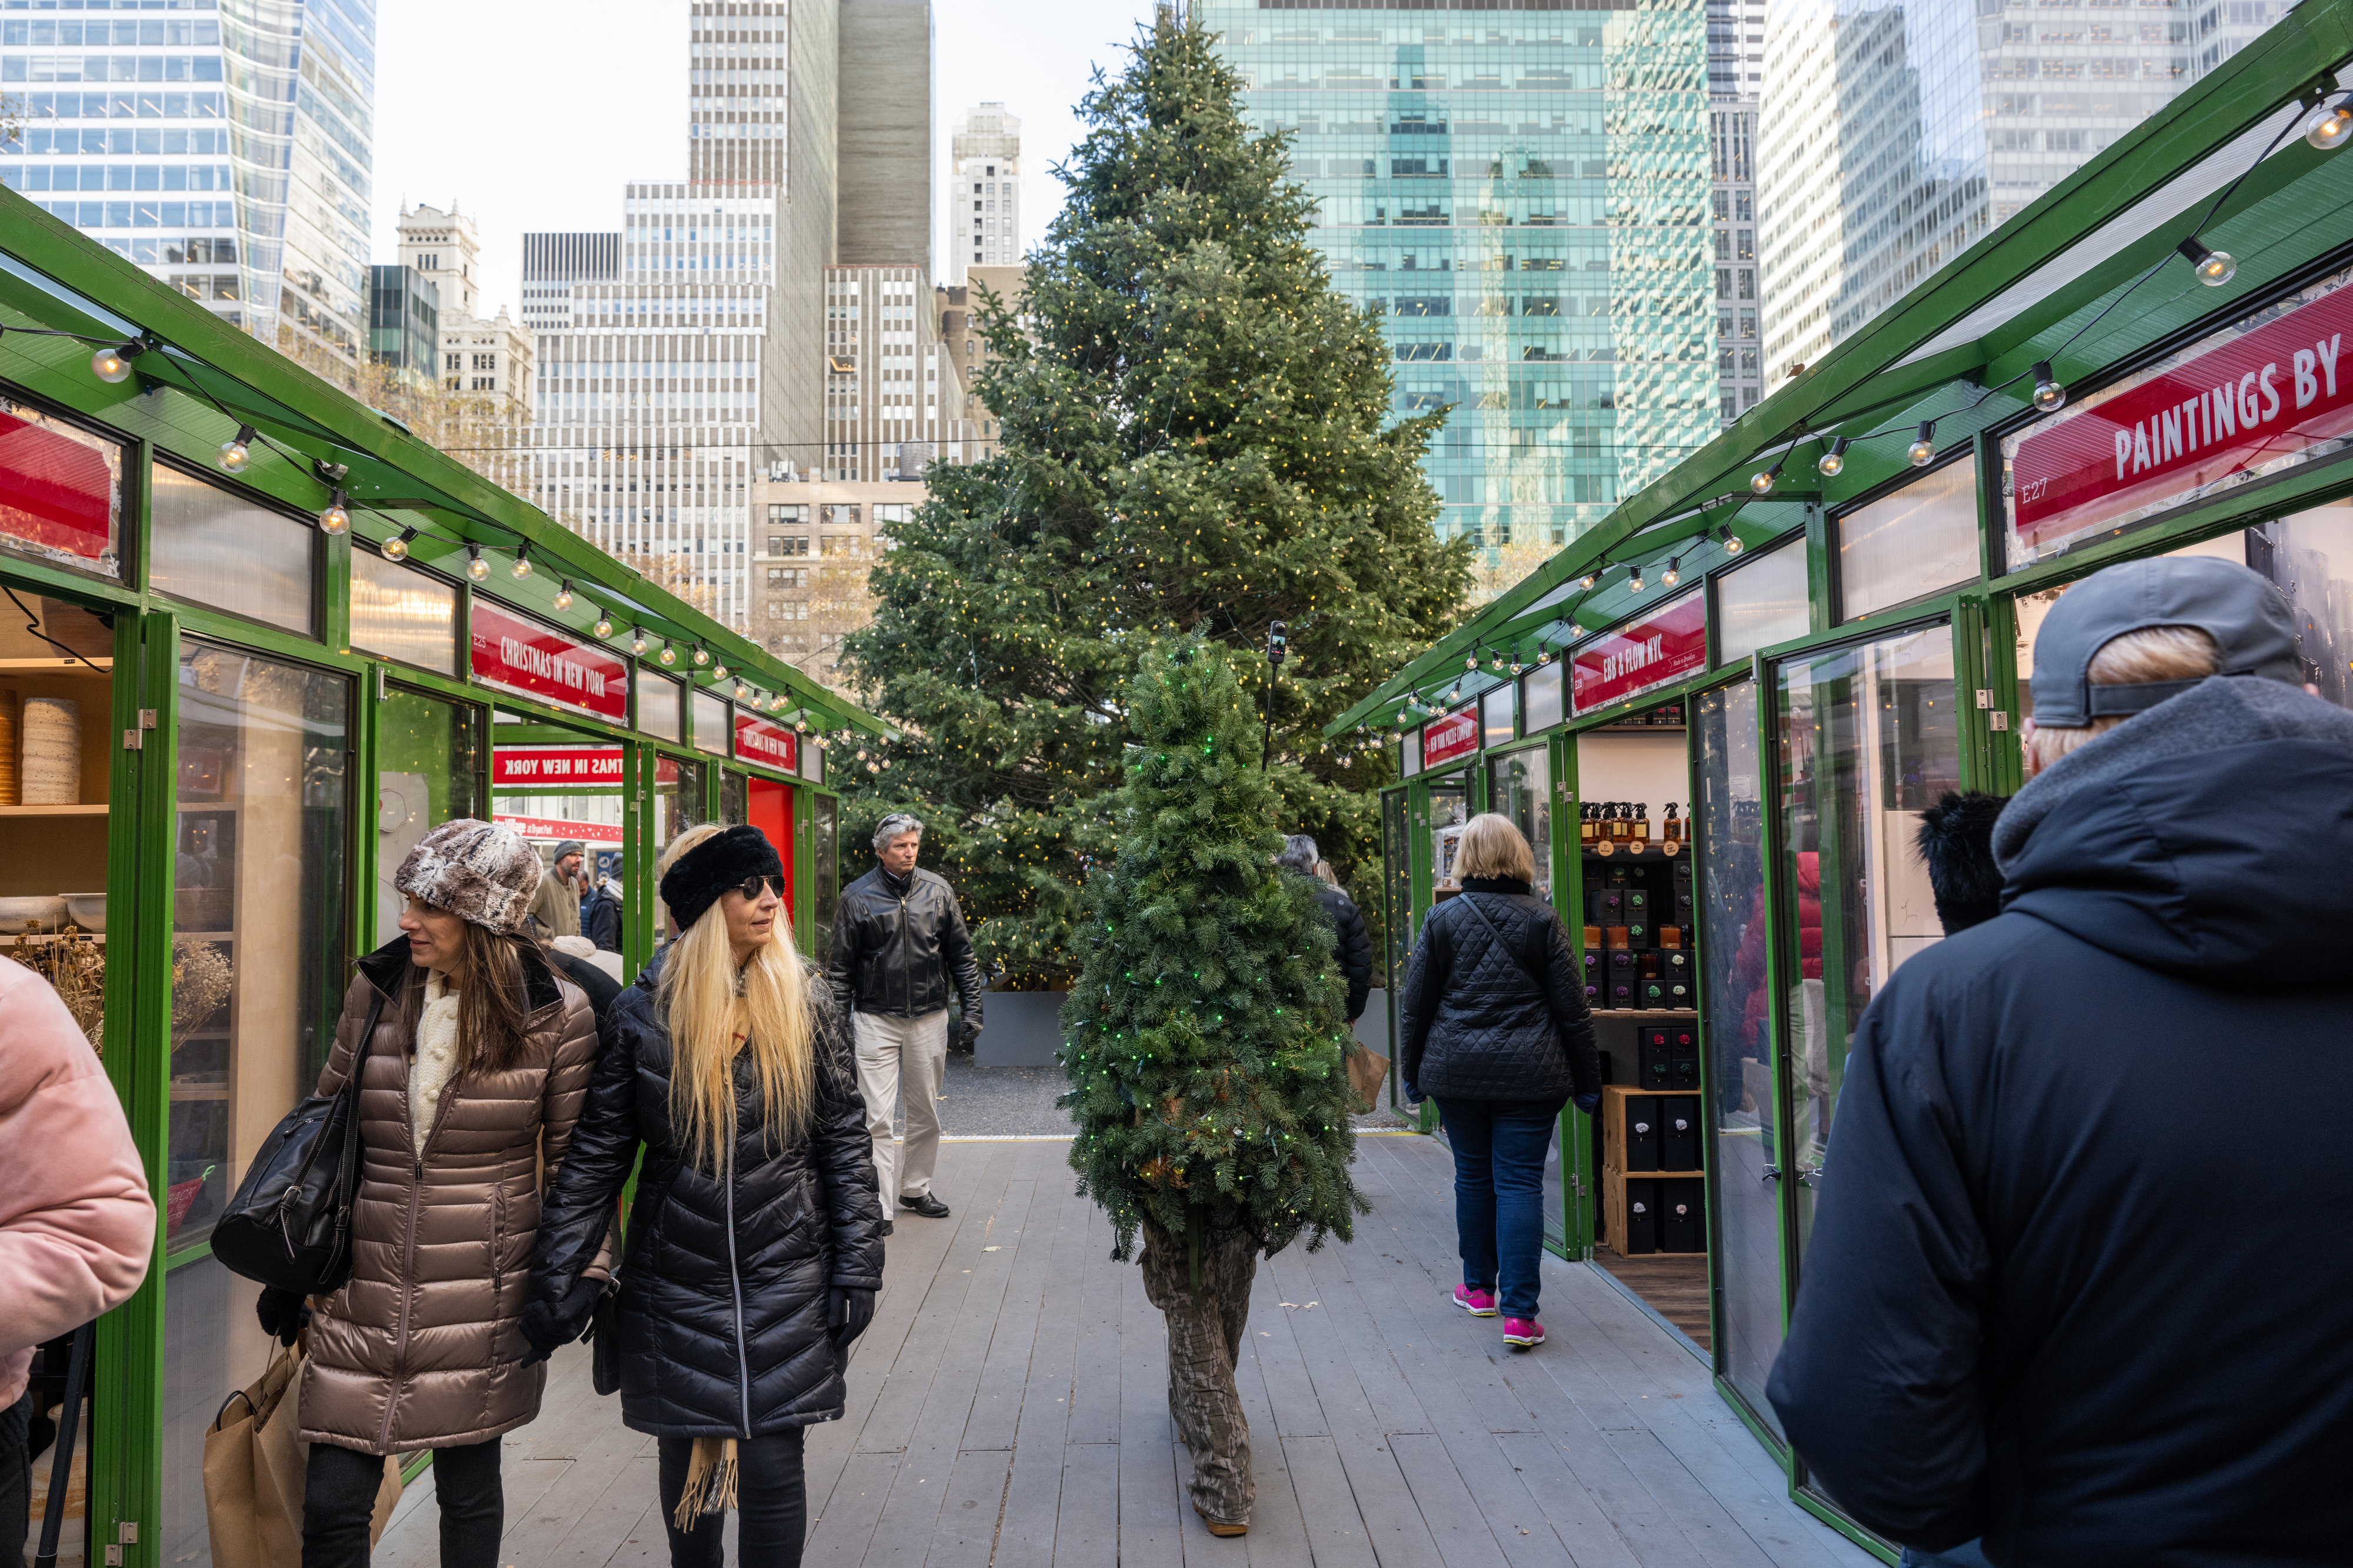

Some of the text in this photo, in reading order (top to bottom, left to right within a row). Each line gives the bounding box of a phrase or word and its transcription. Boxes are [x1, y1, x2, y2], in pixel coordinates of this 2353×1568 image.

[2115, 333, 2341, 481] PAINTINGS BY
[2022, 477, 2048, 504] E27
[474, 633, 486, 648] E25
[501, 636, 605, 698] CHRISTMAS IN NEW YORK
[1603, 633, 1663, 683] EBB & FLOW NYC
[1684, 653, 1695, 662] Brooklyn
[744, 728, 764, 751] CHRISTMAS
[769, 736, 777, 755] NEW
[777, 739, 787, 758] YORK
[1437, 732, 1445, 750] YORK
[1445, 726, 1457, 748] PUZZLE
[1457, 719, 1473, 742] COMPANY
[505, 818, 526, 836] Village
[532, 823, 544, 836] Bryant
[544, 825, 554, 835] Park
[167, 1186, 196, 1205] BACK
[259, 1413, 268, 1427] New
[267, 1400, 279, 1413] York
